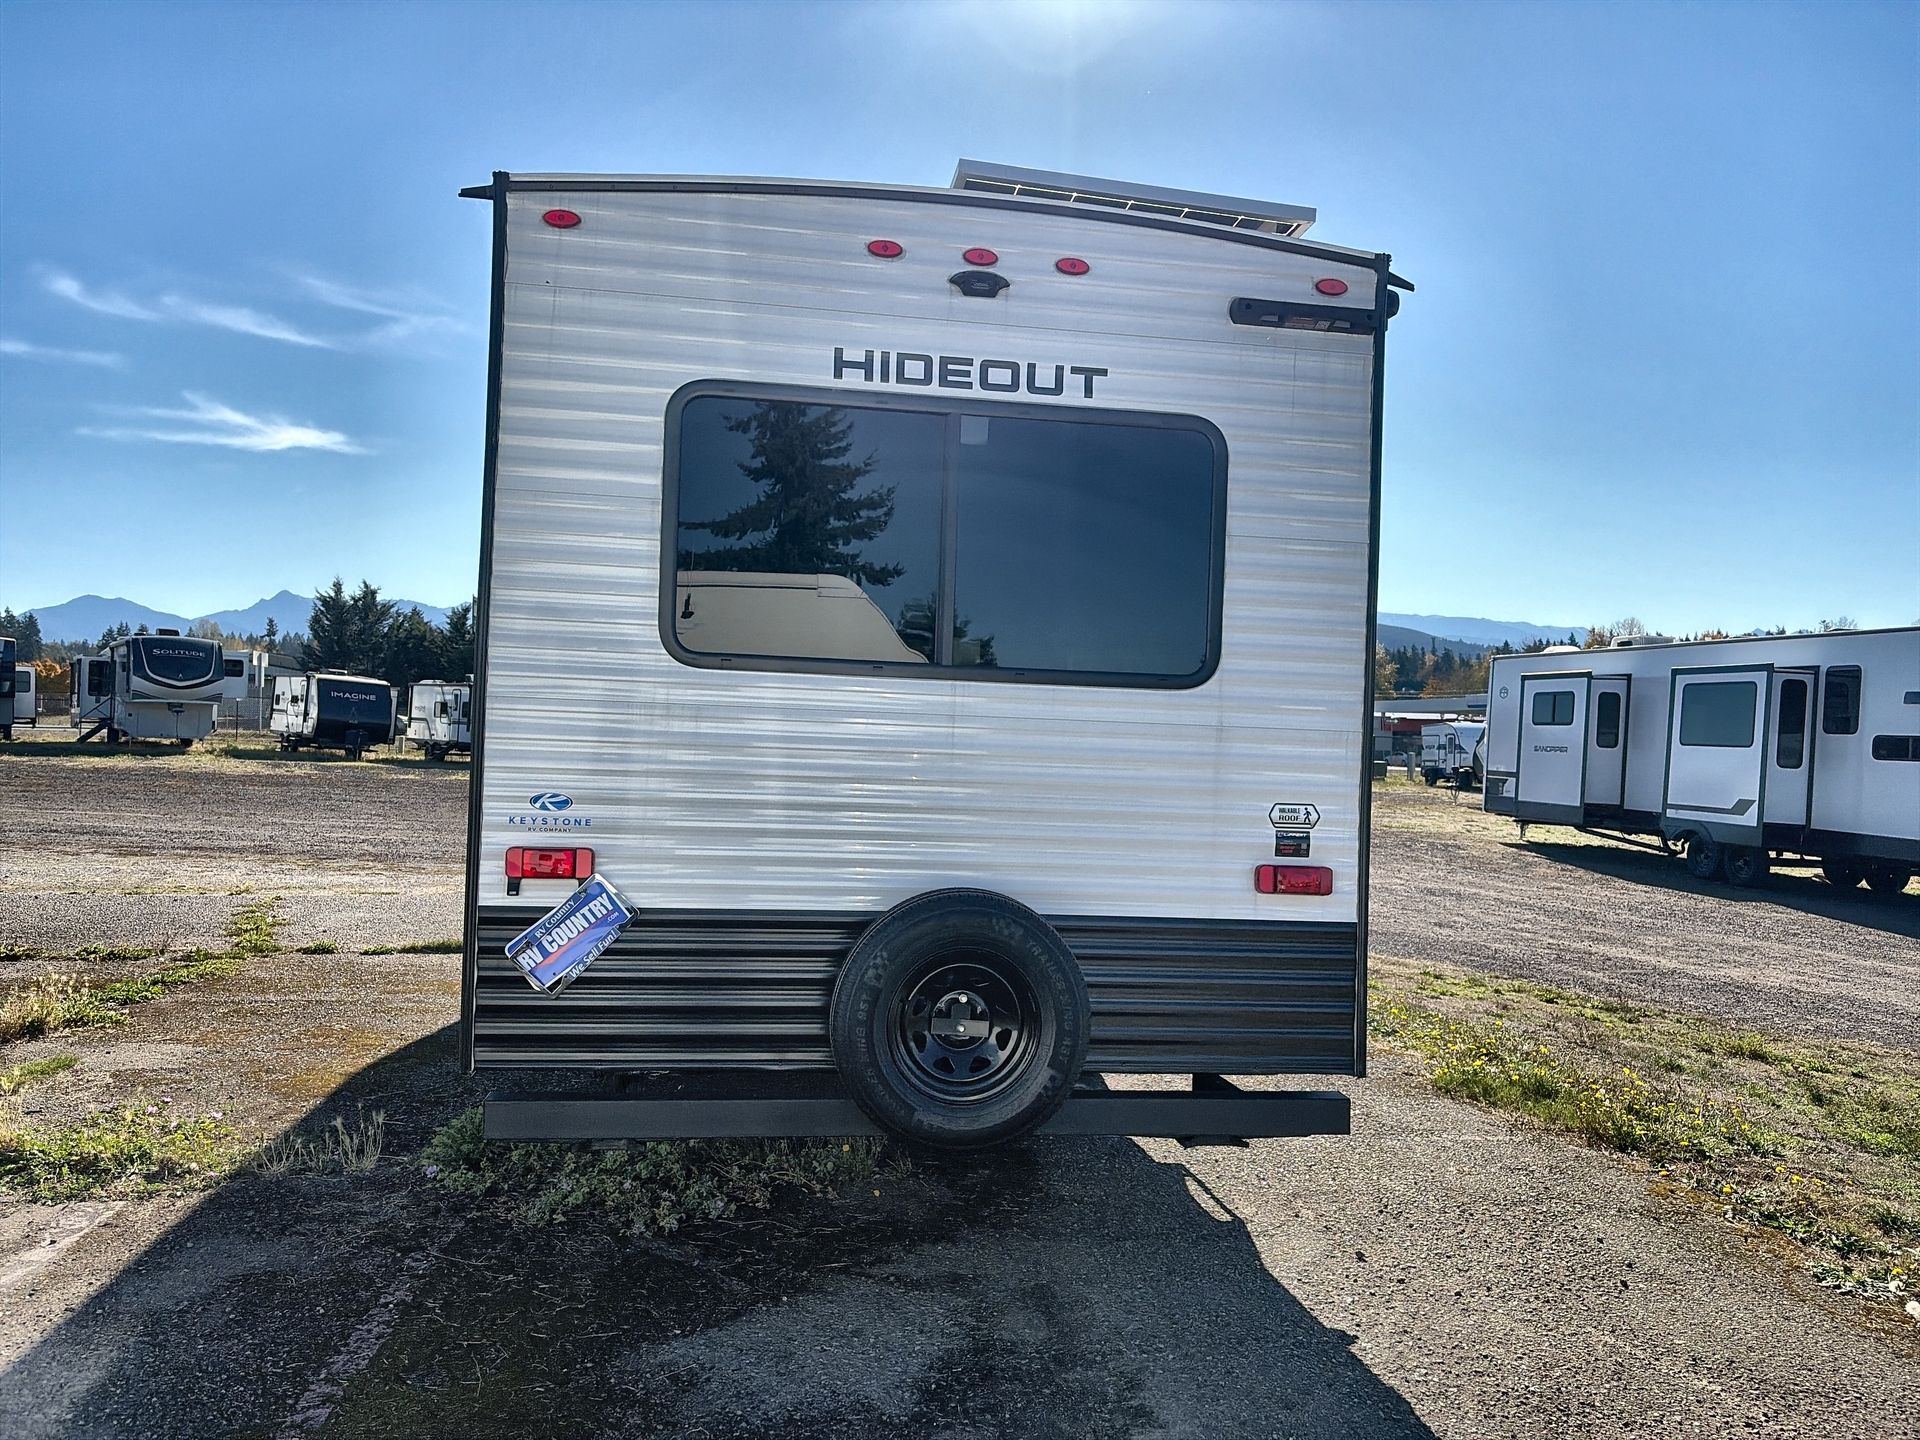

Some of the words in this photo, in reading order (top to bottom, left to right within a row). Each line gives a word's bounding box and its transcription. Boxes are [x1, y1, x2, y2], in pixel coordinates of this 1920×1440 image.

[833, 347, 1109, 399] HIDEOUT
[152, 648, 206, 658] SOLITUDE
[330, 691, 377, 701] IMAGINE
[508, 816, 592, 827] KEYSTONE
[516, 944, 544, 972] RV
[541, 892, 614, 954] COUNTRY
[534, 927, 547, 939] RV
[545, 898, 576, 928] Country
[569, 961, 585, 980] We
[583, 948, 600, 965] Sell
[598, 931, 618, 952] Fun!
